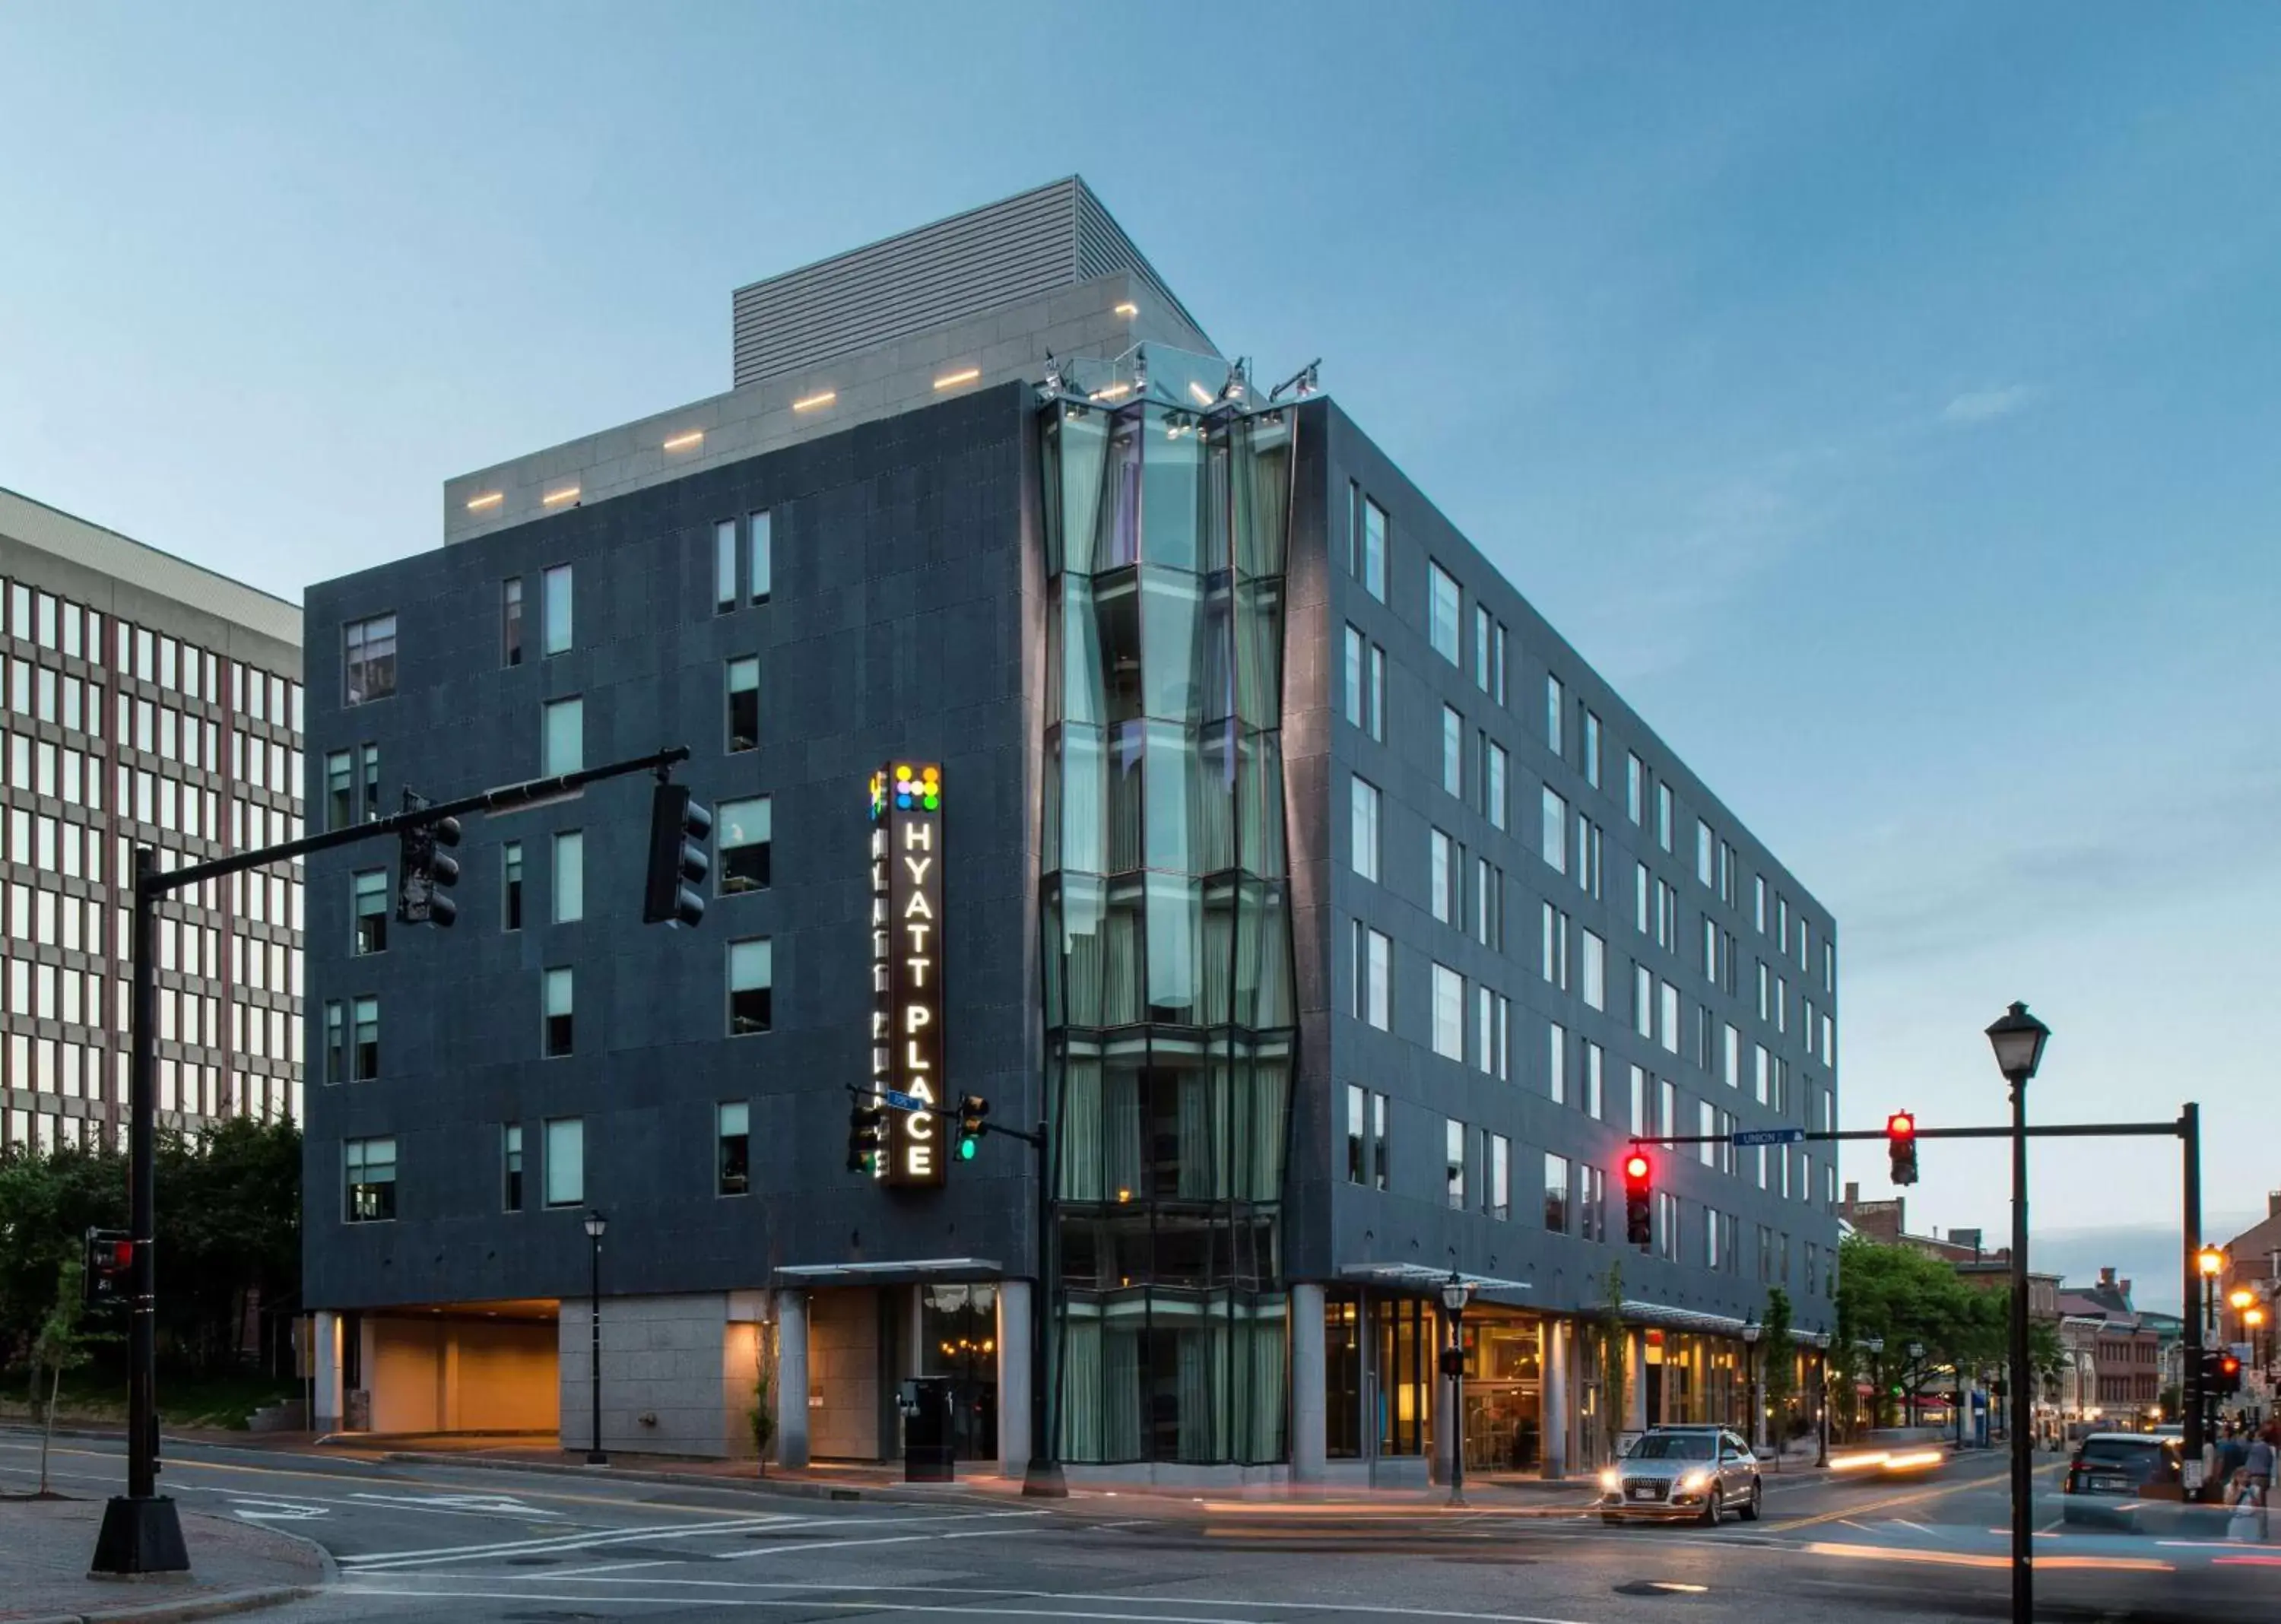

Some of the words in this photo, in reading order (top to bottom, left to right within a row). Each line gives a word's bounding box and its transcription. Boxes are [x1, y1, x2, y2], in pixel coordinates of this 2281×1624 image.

[905, 822, 932, 987] HYATT
[906, 1005, 934, 1175] PLACE
[1743, 1132, 1776, 1144] UNION
